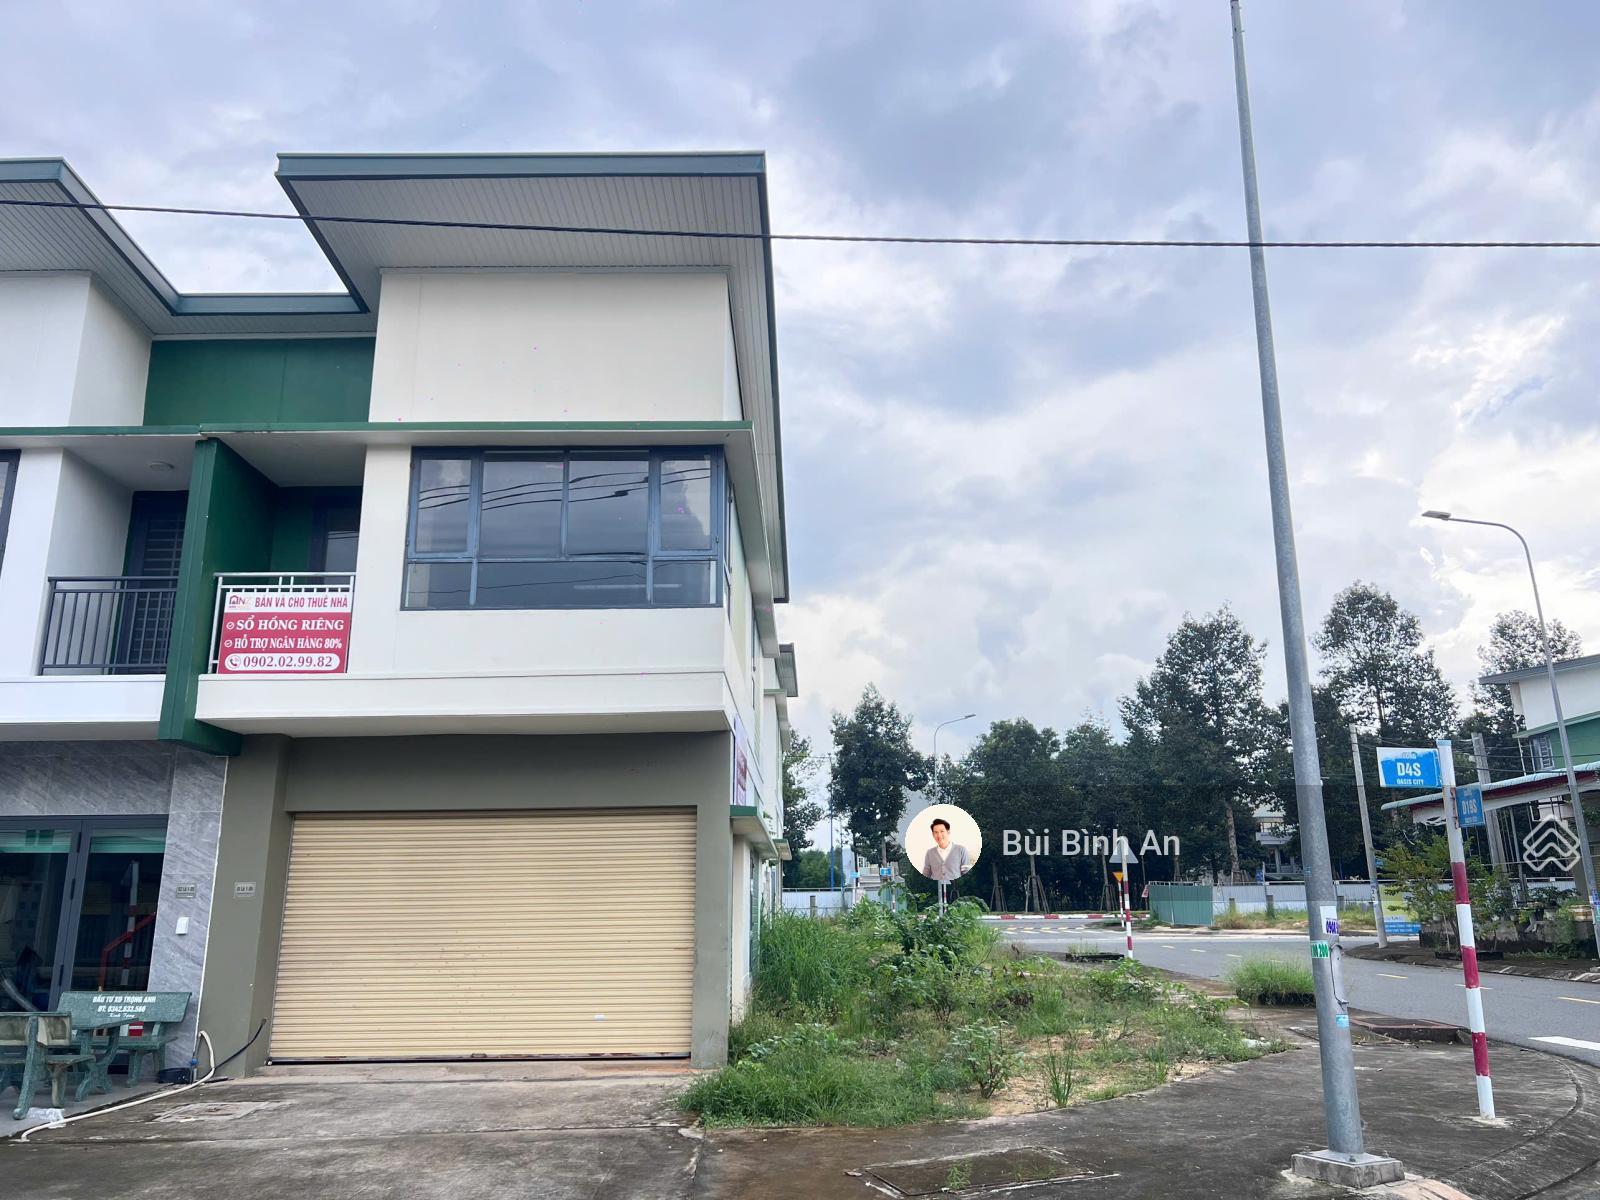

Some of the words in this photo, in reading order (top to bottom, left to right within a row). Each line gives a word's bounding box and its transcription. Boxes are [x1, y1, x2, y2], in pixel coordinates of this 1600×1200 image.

[288, 597, 305, 608] CHO
[307, 595, 328, 608] THUÊ
[236, 615, 255, 630] SỔ
[301, 617, 344, 630] RIÊNG
[250, 637, 268, 651] TRỢ
[324, 638, 342, 649] 80%
[243, 655, 333, 668] 0902.02.99.82
[1397, 762, 1421, 777] D4S
